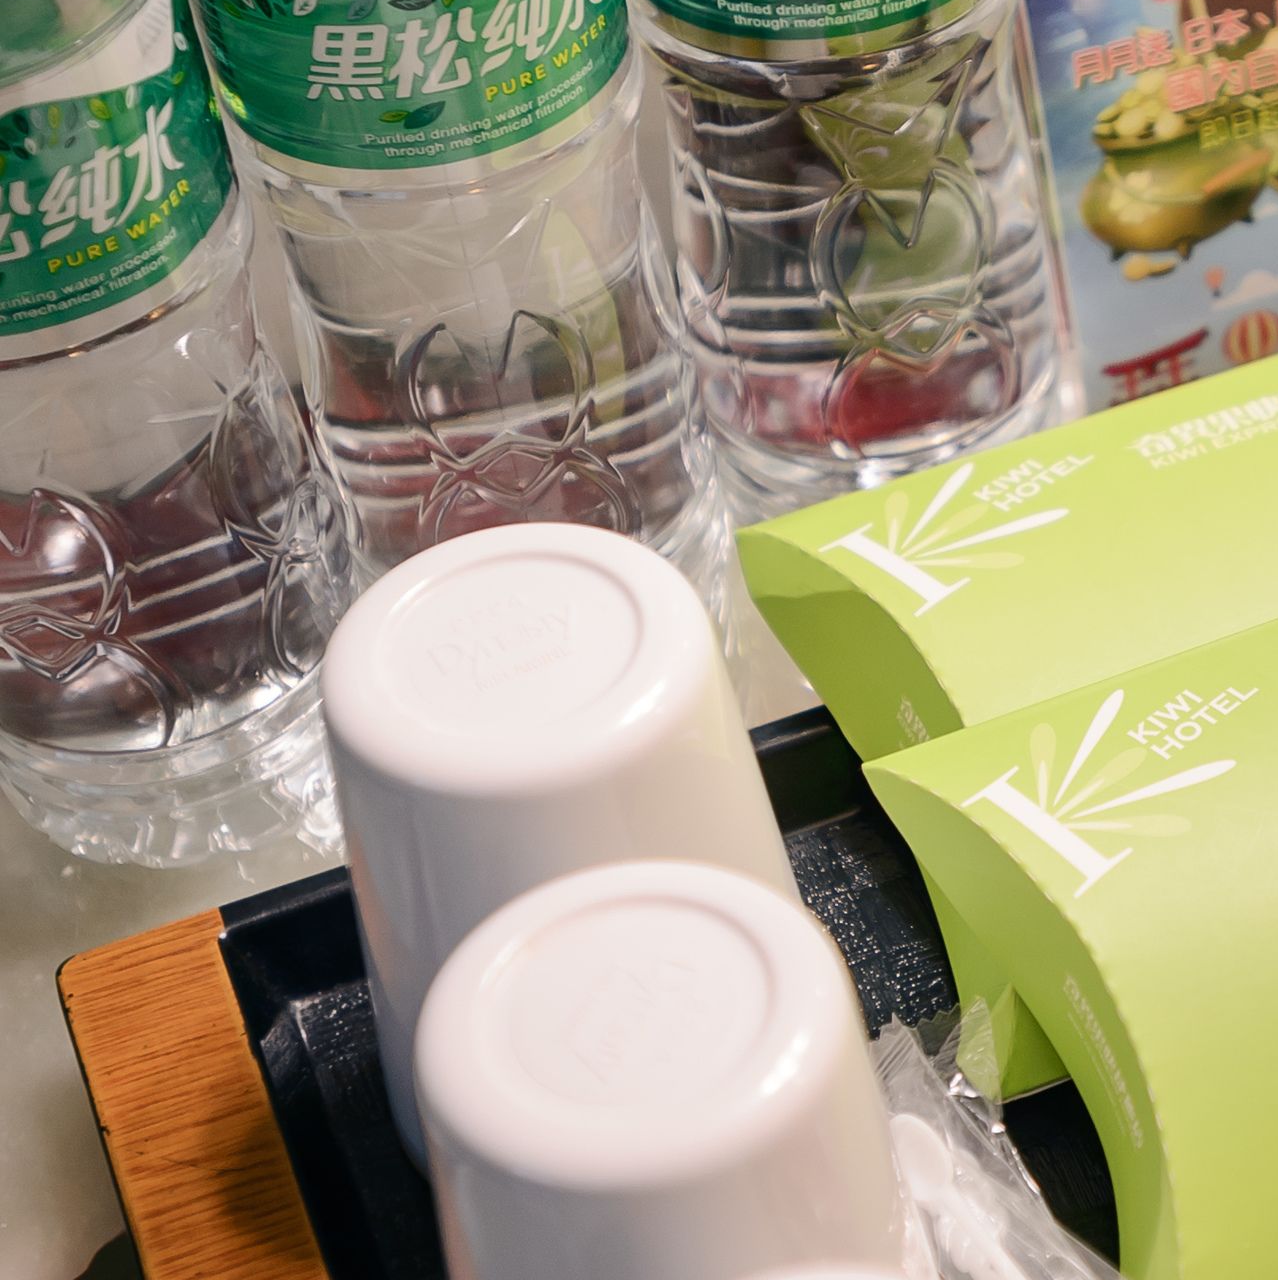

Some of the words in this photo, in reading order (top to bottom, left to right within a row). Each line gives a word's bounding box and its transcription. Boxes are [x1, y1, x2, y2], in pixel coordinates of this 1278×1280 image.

[733, 14, 790, 31] through
[794, 10, 879, 29] mechanical
[776, 1, 836, 16] drinking
[484, 64, 547, 103] PURE
[552, 14, 608, 69] WATER
[384, 145, 445, 158] through
[450, 114, 533, 150] mechanical
[535, 85, 586, 122] filtration.
[431, 119, 493, 141] drinking
[495, 100, 534, 122] water
[47, 236, 120, 273] PURE
[126, 179, 191, 241] WATER
[0, 283, 57, 308] rinking
[61, 272, 105, 295] water
[12, 286, 105, 322] mechanical
[1149, 440, 1208, 471] KIWI
[974, 459, 1043, 504] KIWI
[993, 453, 1094, 512] HOTEL
[1127, 687, 1203, 746] KIWI
[1151, 682, 1260, 761] HOTEL
